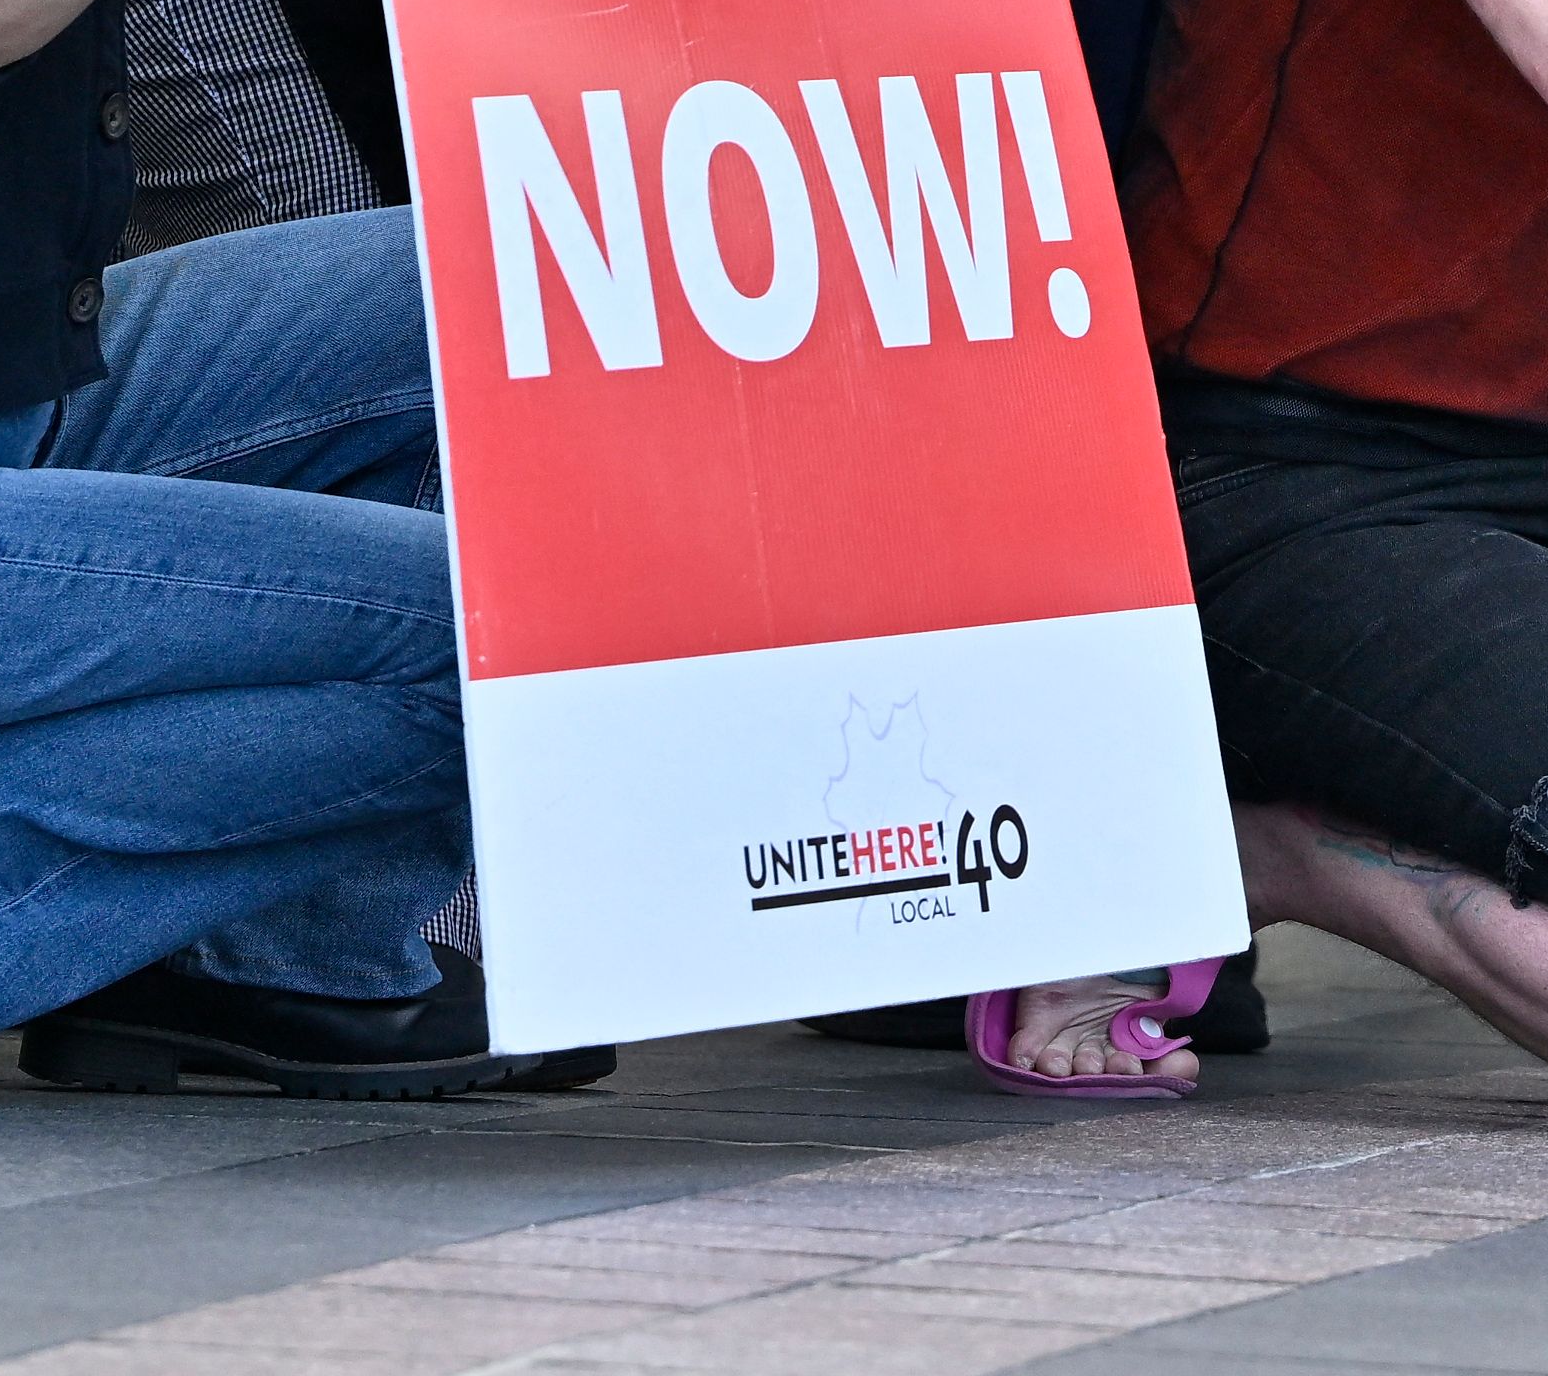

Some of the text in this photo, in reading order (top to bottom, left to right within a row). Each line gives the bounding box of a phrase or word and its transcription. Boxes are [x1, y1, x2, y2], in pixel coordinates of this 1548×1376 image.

[470, 68, 1094, 382] NOW!
[743, 803, 1029, 913] UNITEHERE! 40
[890, 894, 956, 925] LOCAL
